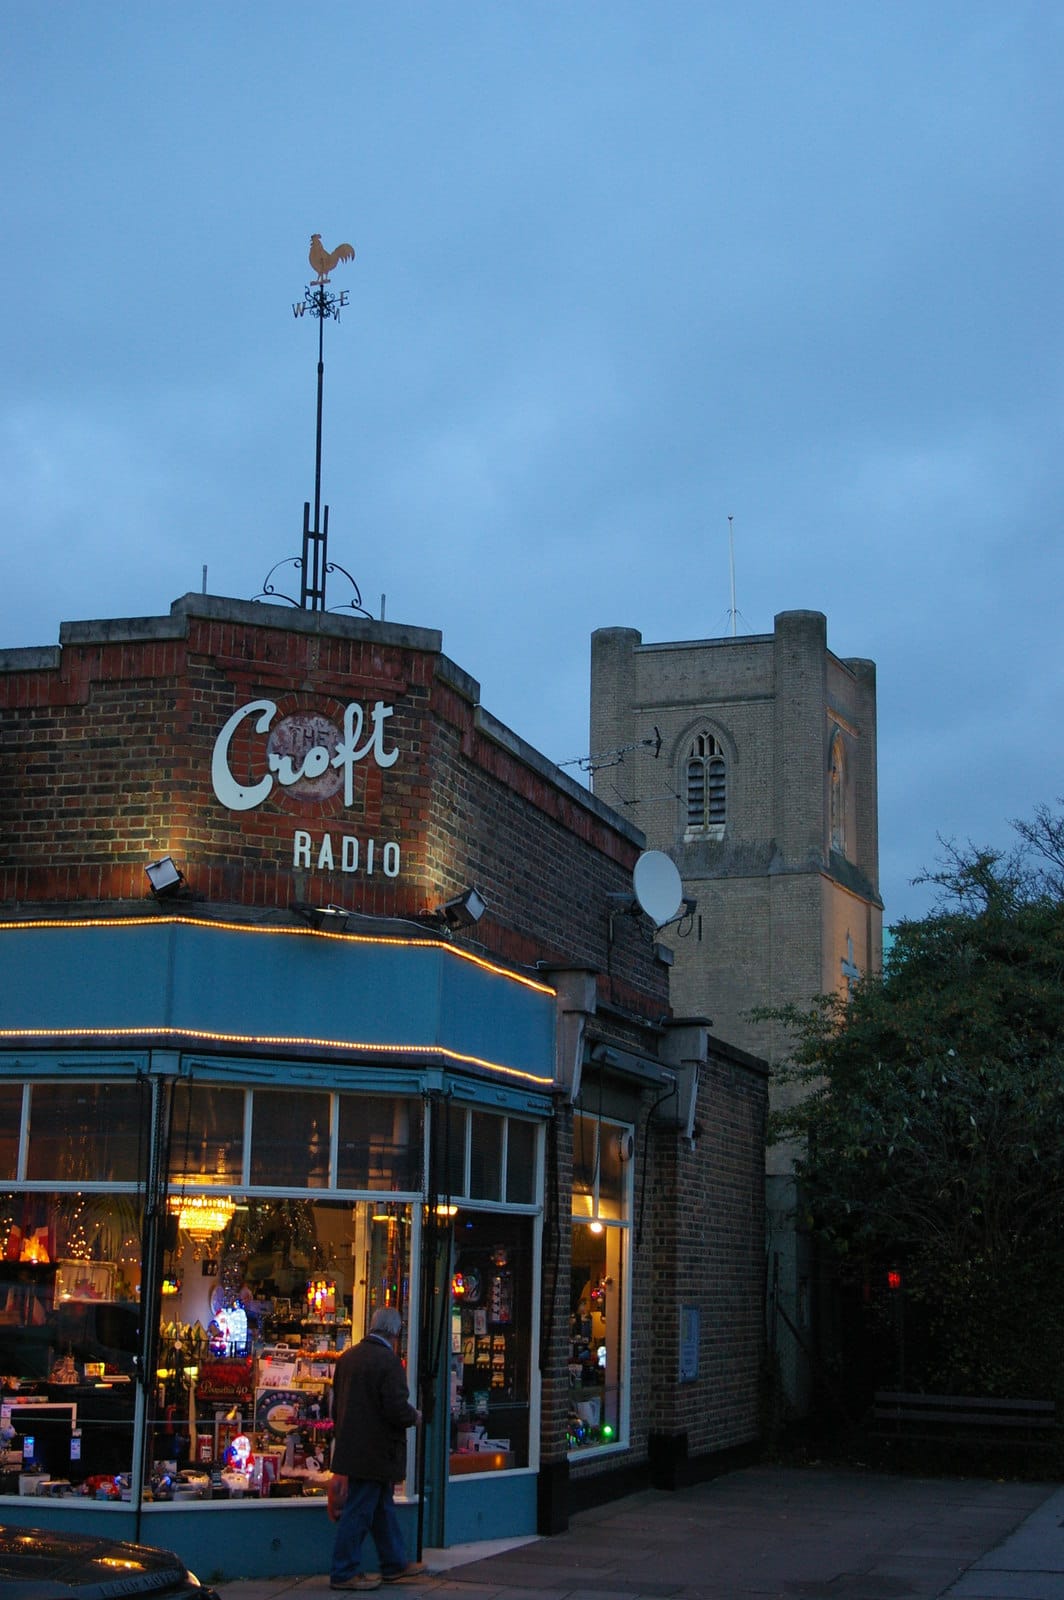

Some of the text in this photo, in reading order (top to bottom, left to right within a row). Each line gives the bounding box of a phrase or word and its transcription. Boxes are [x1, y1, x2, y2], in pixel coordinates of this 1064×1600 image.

[292, 301, 307, 318] W
[340, 289, 350, 307] E
[288, 725, 330, 750] THE
[211, 699, 399, 811] Croft
[293, 829, 400, 878] RADIO
